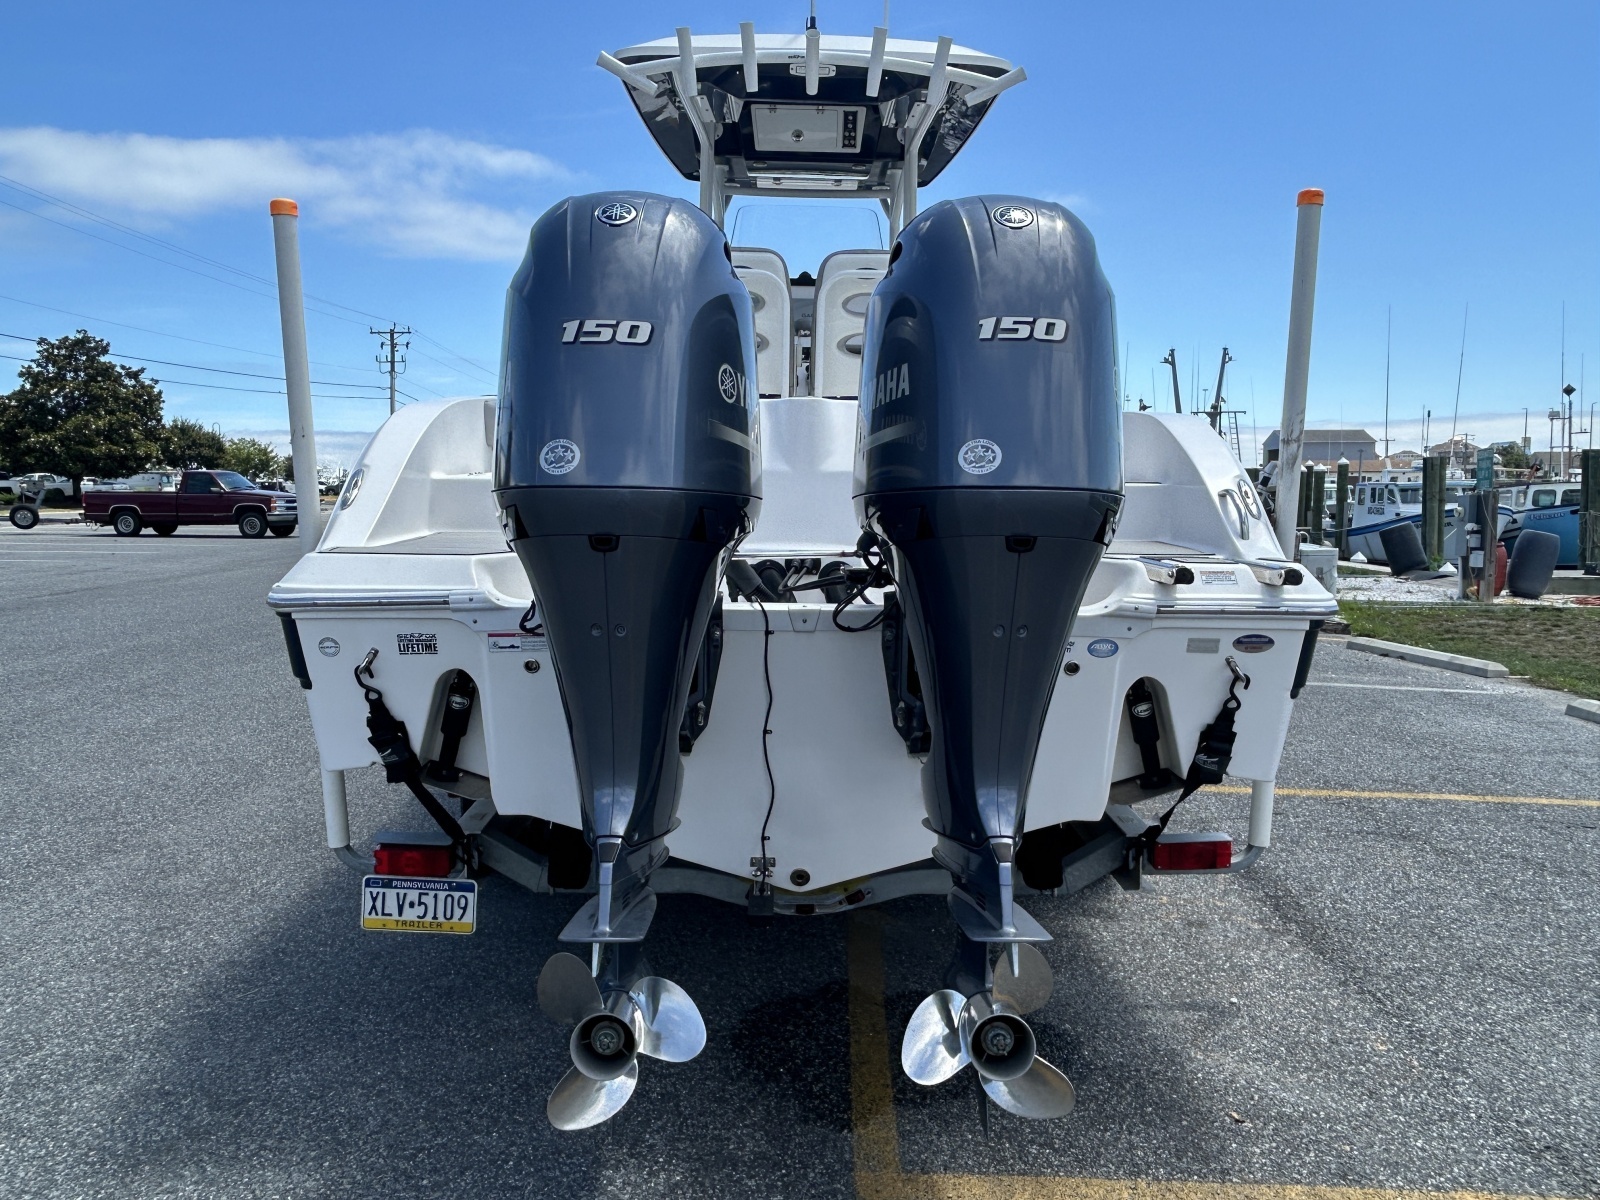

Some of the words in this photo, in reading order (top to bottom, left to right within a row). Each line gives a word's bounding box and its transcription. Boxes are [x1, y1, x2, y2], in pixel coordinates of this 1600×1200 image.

[561, 319, 652, 344] 150
[978, 316, 1068, 341] 150
[398, 643, 438, 652] LIFETIME
[392, 881, 449, 890] PENNSYLVANIA
[394, 919, 443, 929] TRAILER
